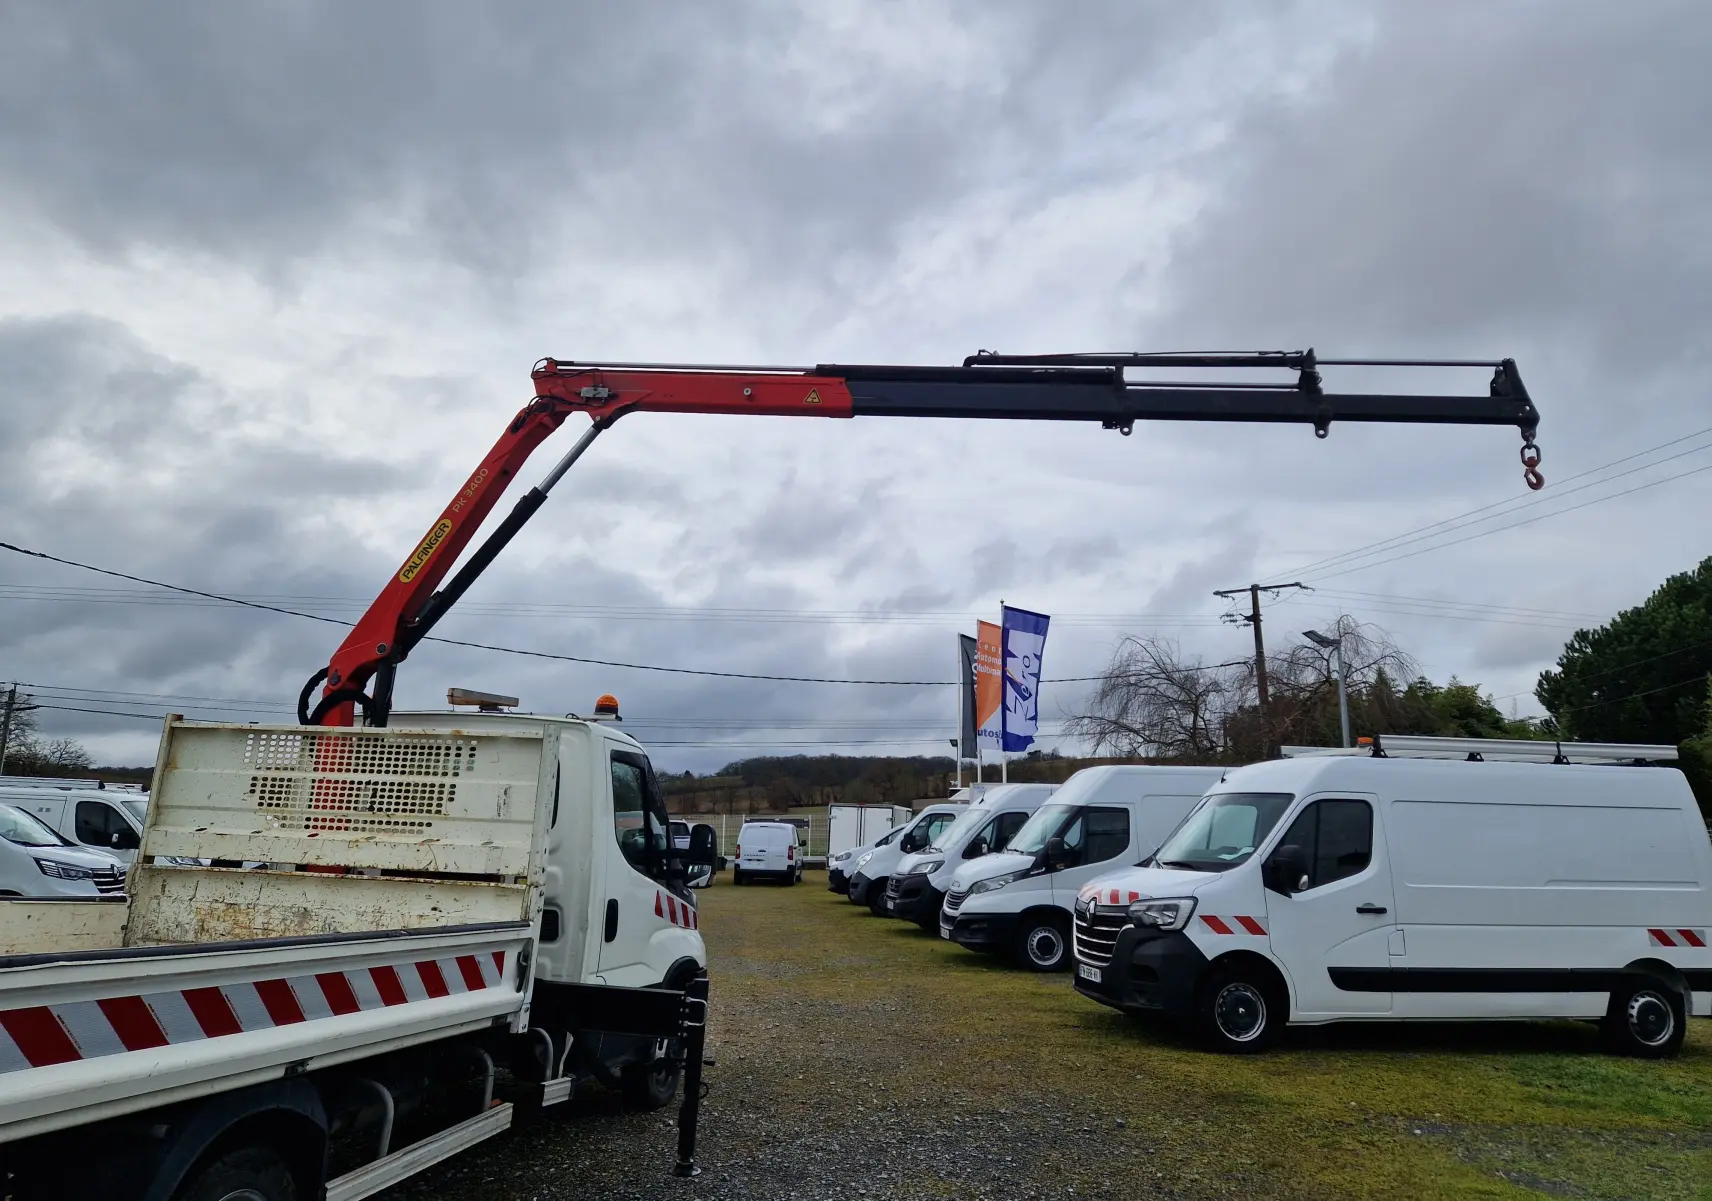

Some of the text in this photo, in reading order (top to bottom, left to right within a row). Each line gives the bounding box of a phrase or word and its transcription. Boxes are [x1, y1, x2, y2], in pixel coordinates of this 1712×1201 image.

[452, 468, 489, 513] PK 3400
[401, 522, 450, 580] PALFINGER
